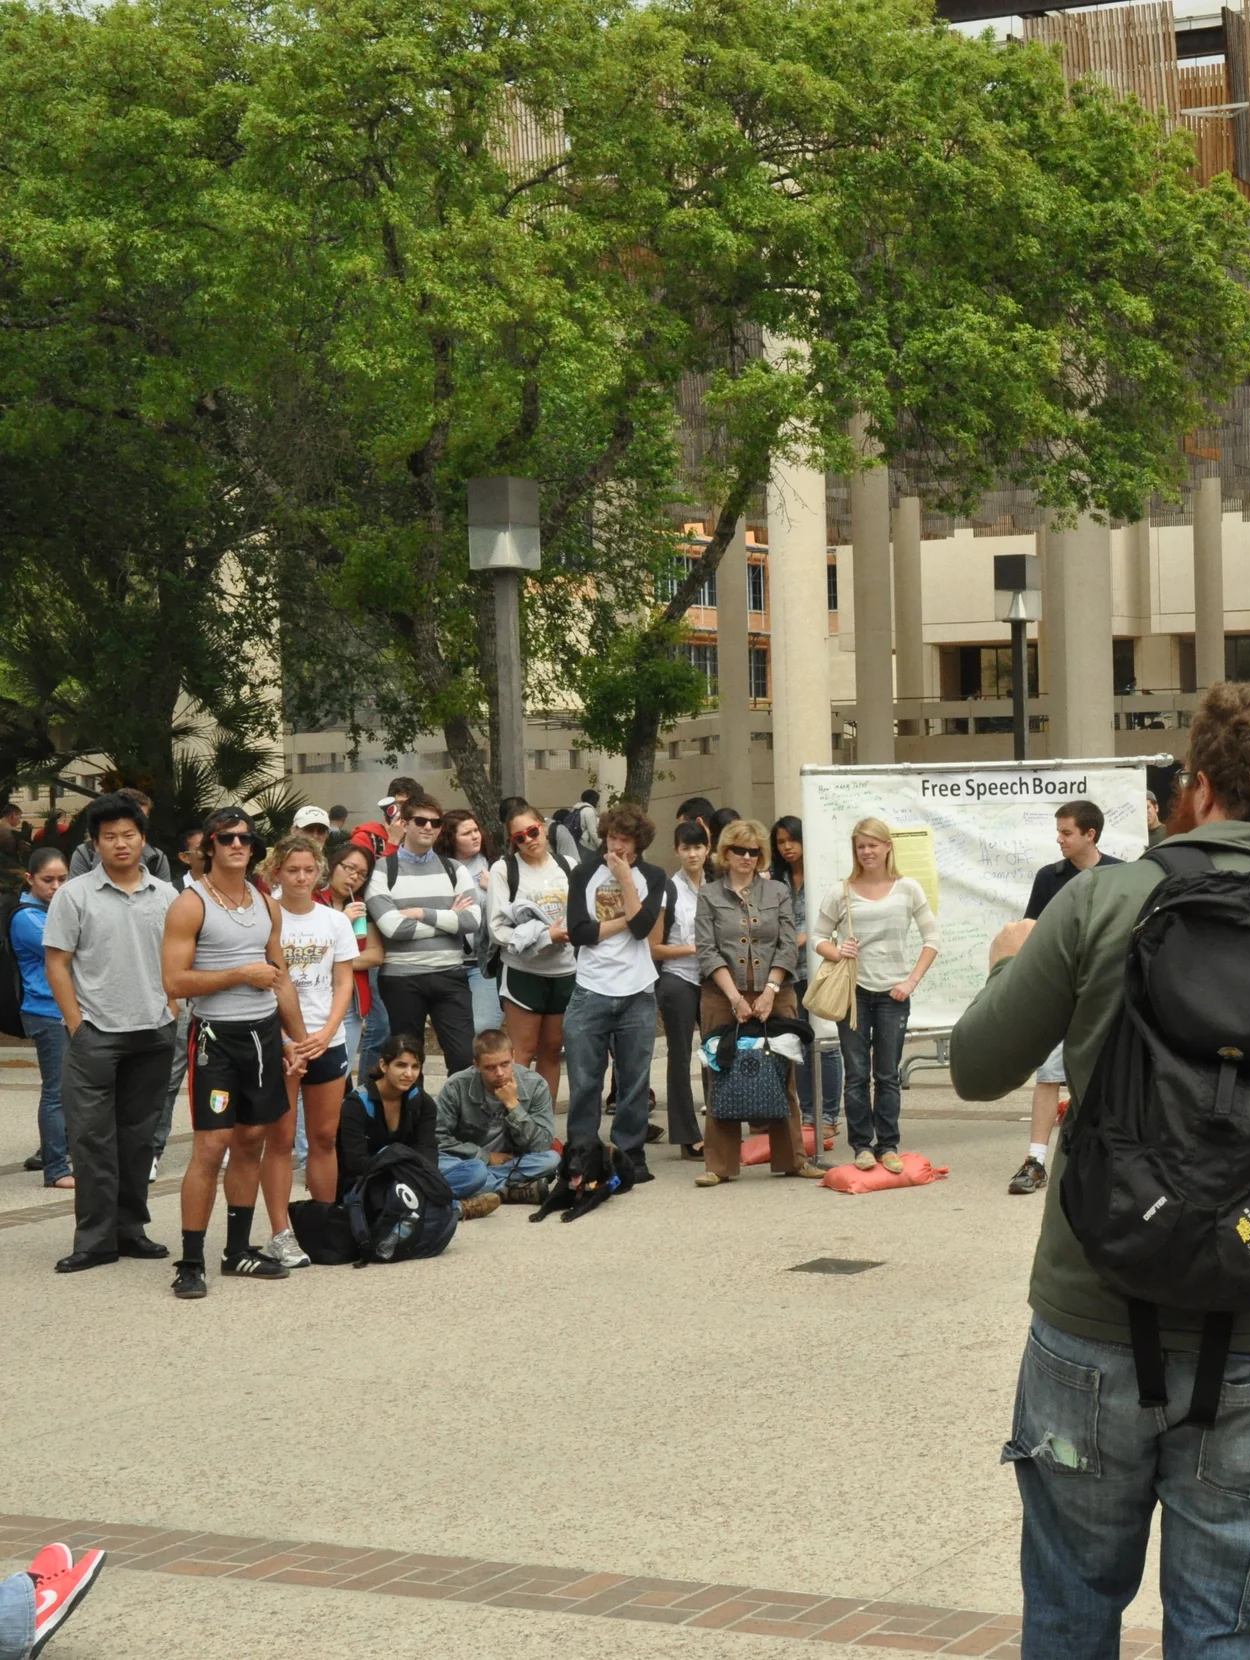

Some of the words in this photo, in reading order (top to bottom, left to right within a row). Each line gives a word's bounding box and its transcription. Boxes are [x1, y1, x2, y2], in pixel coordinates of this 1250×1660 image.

[921, 780, 961, 797] Free
[965, 777, 1030, 800] Speech
[1033, 776, 1087, 794] Board
